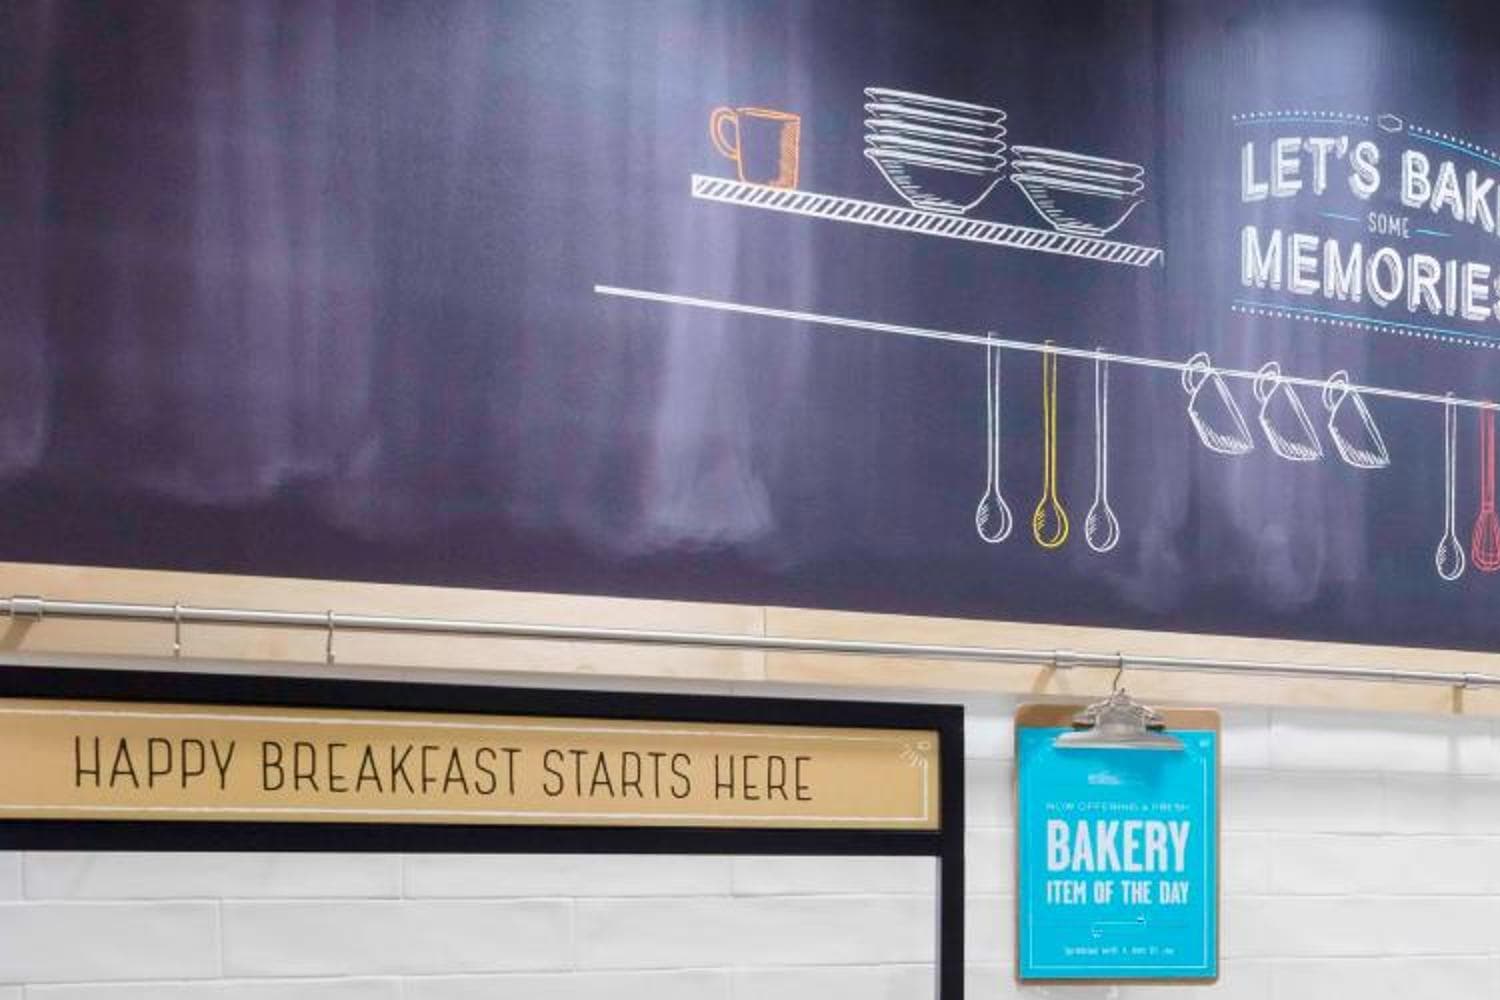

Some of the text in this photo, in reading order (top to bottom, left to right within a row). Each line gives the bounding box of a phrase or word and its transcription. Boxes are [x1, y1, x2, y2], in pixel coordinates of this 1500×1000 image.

[1241, 135, 1381, 202] LET'S
[1368, 211, 1409, 239] SOME
[75, 735, 814, 802] HAPPY BREAKFAST STARTS HERE
[1047, 819, 1190, 872] BAKERY
[1047, 880, 1189, 904] ITEM OF THE DAY
